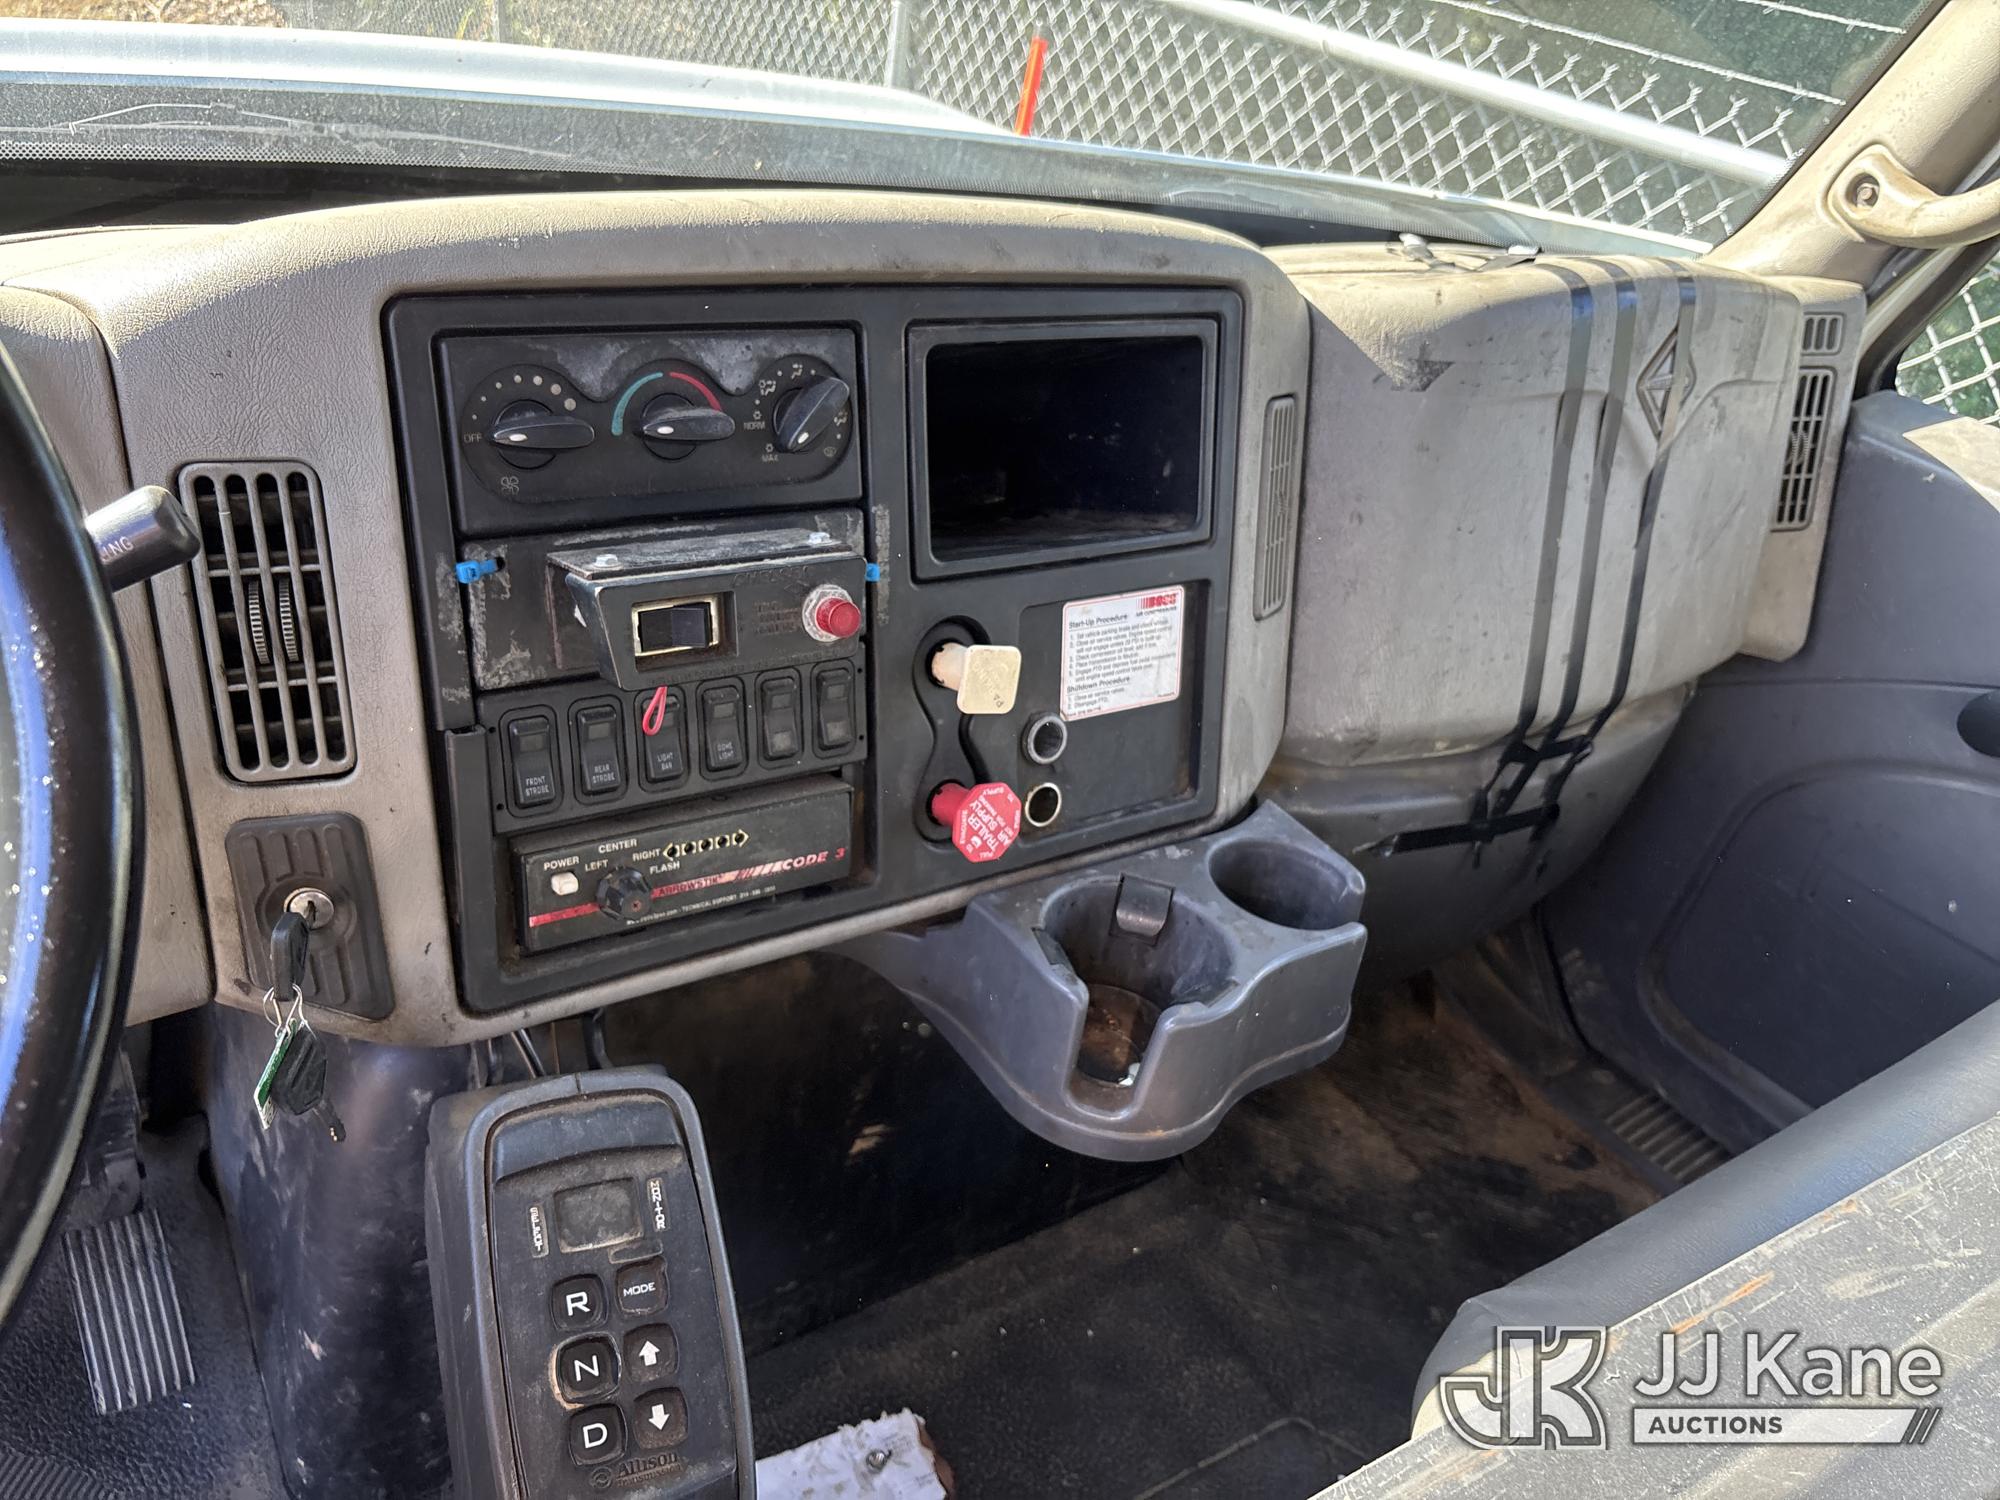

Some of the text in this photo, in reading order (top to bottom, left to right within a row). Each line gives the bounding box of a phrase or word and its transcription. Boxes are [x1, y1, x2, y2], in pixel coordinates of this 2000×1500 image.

[463, 433, 482, 443] OFF
[1069, 613, 1127, 629] Start-Up Procedure
[1067, 676, 1130, 693] Shutdown Procedure
[717, 741, 733, 751] DOME
[657, 752, 673, 762] LIGHT
[719, 750, 735, 760] LIGHT
[594, 763, 610, 773] REAR
[661, 761, 673, 771] BAR
[525, 776, 546, 786] FRONT
[592, 772, 615, 784] STROBE
[525, 785, 549, 797] STROBE
[969, 800, 999, 831] SUPPLY
[967, 813, 999, 852] TRAILER
[598, 838, 638, 854] CENTER
[632, 848, 661, 862] RIGHT
[782, 847, 846, 870] CODE 3
[543, 856, 580, 871] POWER
[584, 859, 609, 872] LEFT
[649, 861, 680, 875] FLASH
[682, 900, 711, 911] TECHNICAL
[711, 894, 737, 905] SUPPORT
[650, 1180, 666, 1229] MONITOR
[530, 1206, 543, 1251] SELECT
[623, 1282, 656, 1297] MODE
[566, 1291, 591, 1316] R
[573, 1355, 600, 1382] N
[582, 1423, 608, 1449] D
[618, 1452, 678, 1478] Allison
